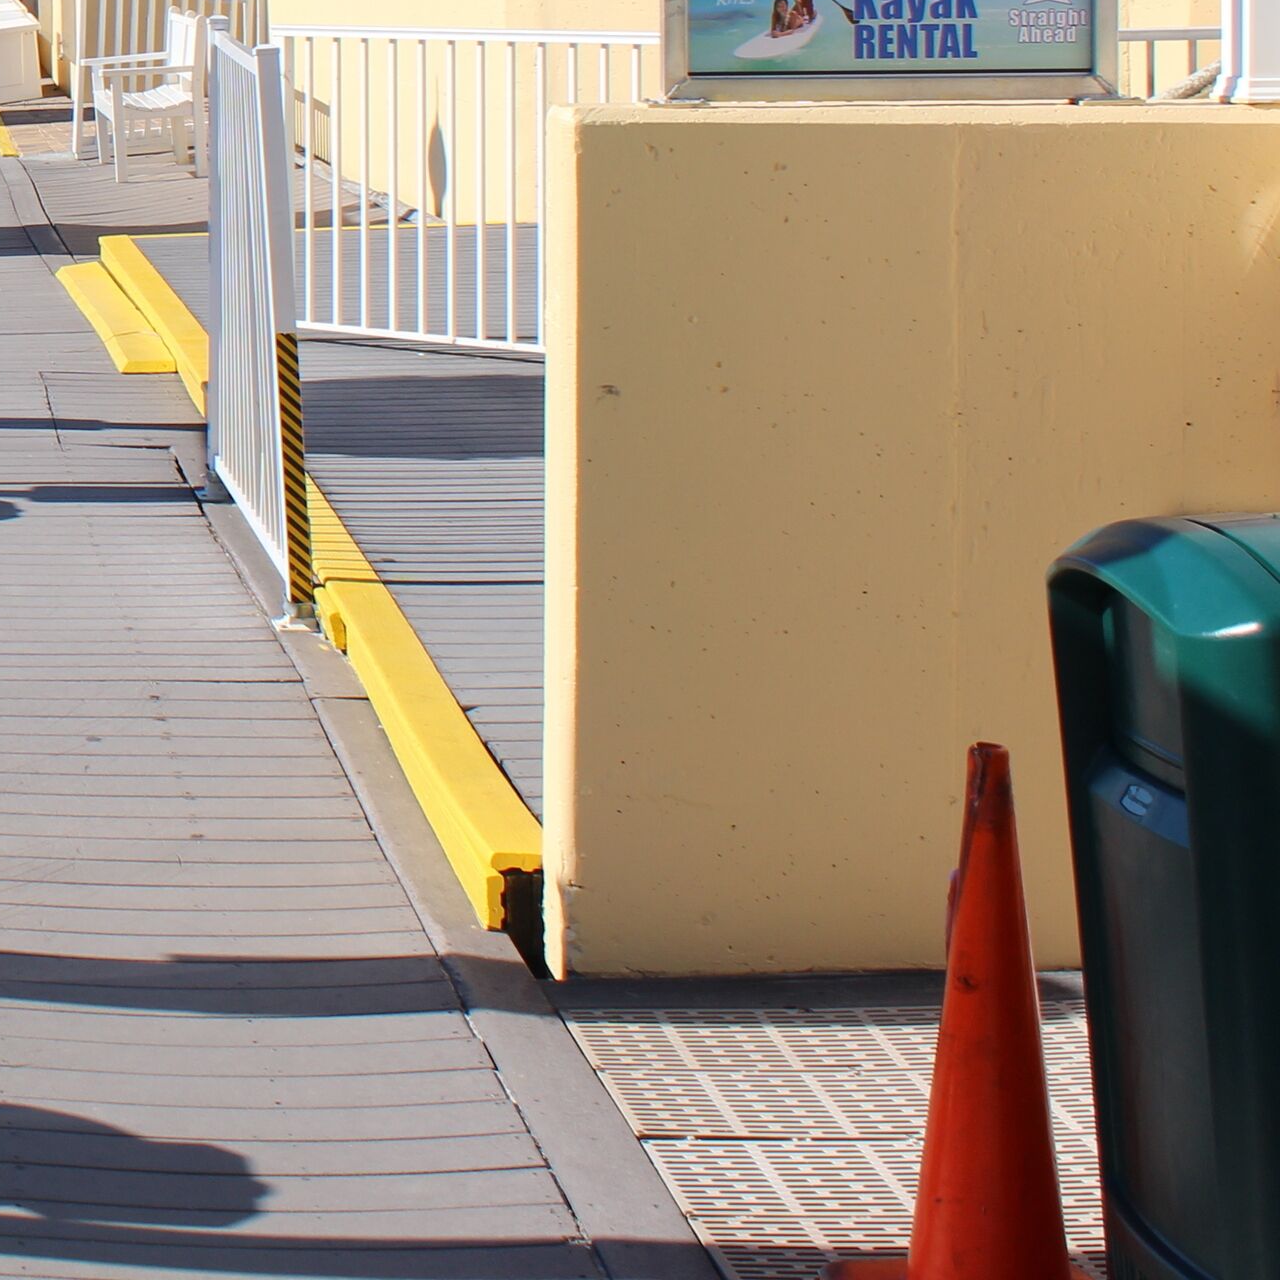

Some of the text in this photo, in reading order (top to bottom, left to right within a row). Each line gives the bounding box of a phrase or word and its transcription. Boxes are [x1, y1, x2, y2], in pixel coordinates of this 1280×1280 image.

[1008, 8, 1088, 30] Straight
[854, 23, 978, 60] RENTAL
[1018, 26, 1077, 44] Ahead
